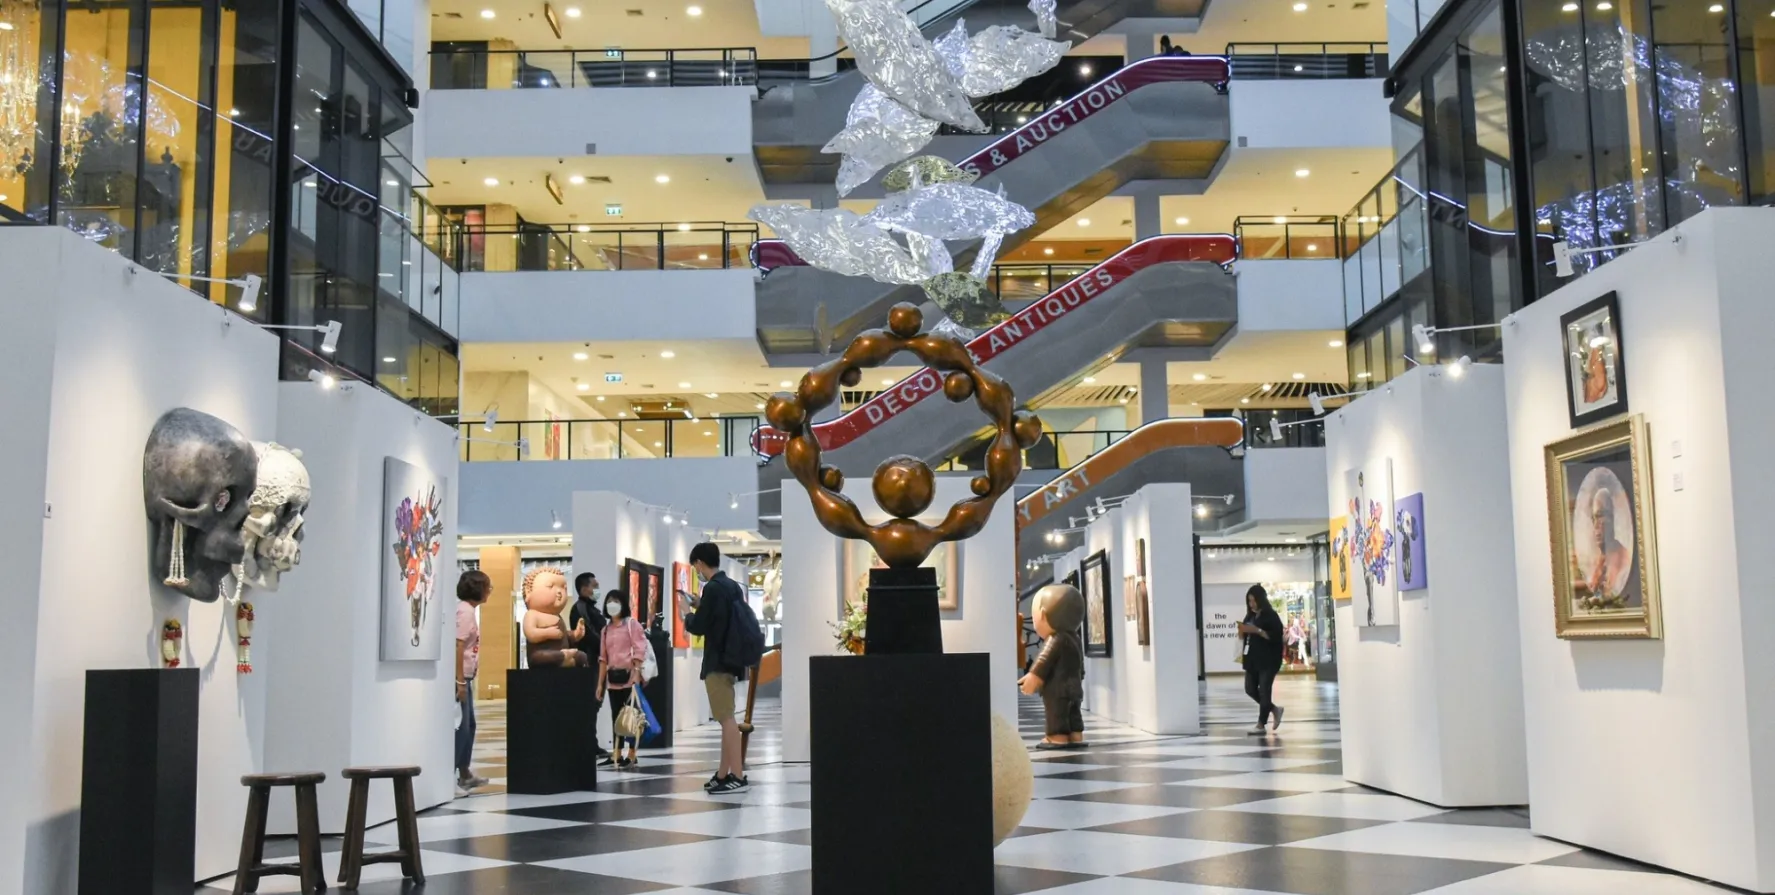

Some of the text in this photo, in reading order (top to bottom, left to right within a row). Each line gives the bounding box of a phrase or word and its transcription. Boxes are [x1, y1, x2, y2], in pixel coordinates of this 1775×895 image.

[990, 149, 1008, 166] &
[1016, 79, 1125, 154] AUCTION
[989, 268, 1113, 354] ANTIQUES
[1043, 467, 1089, 511] ART
